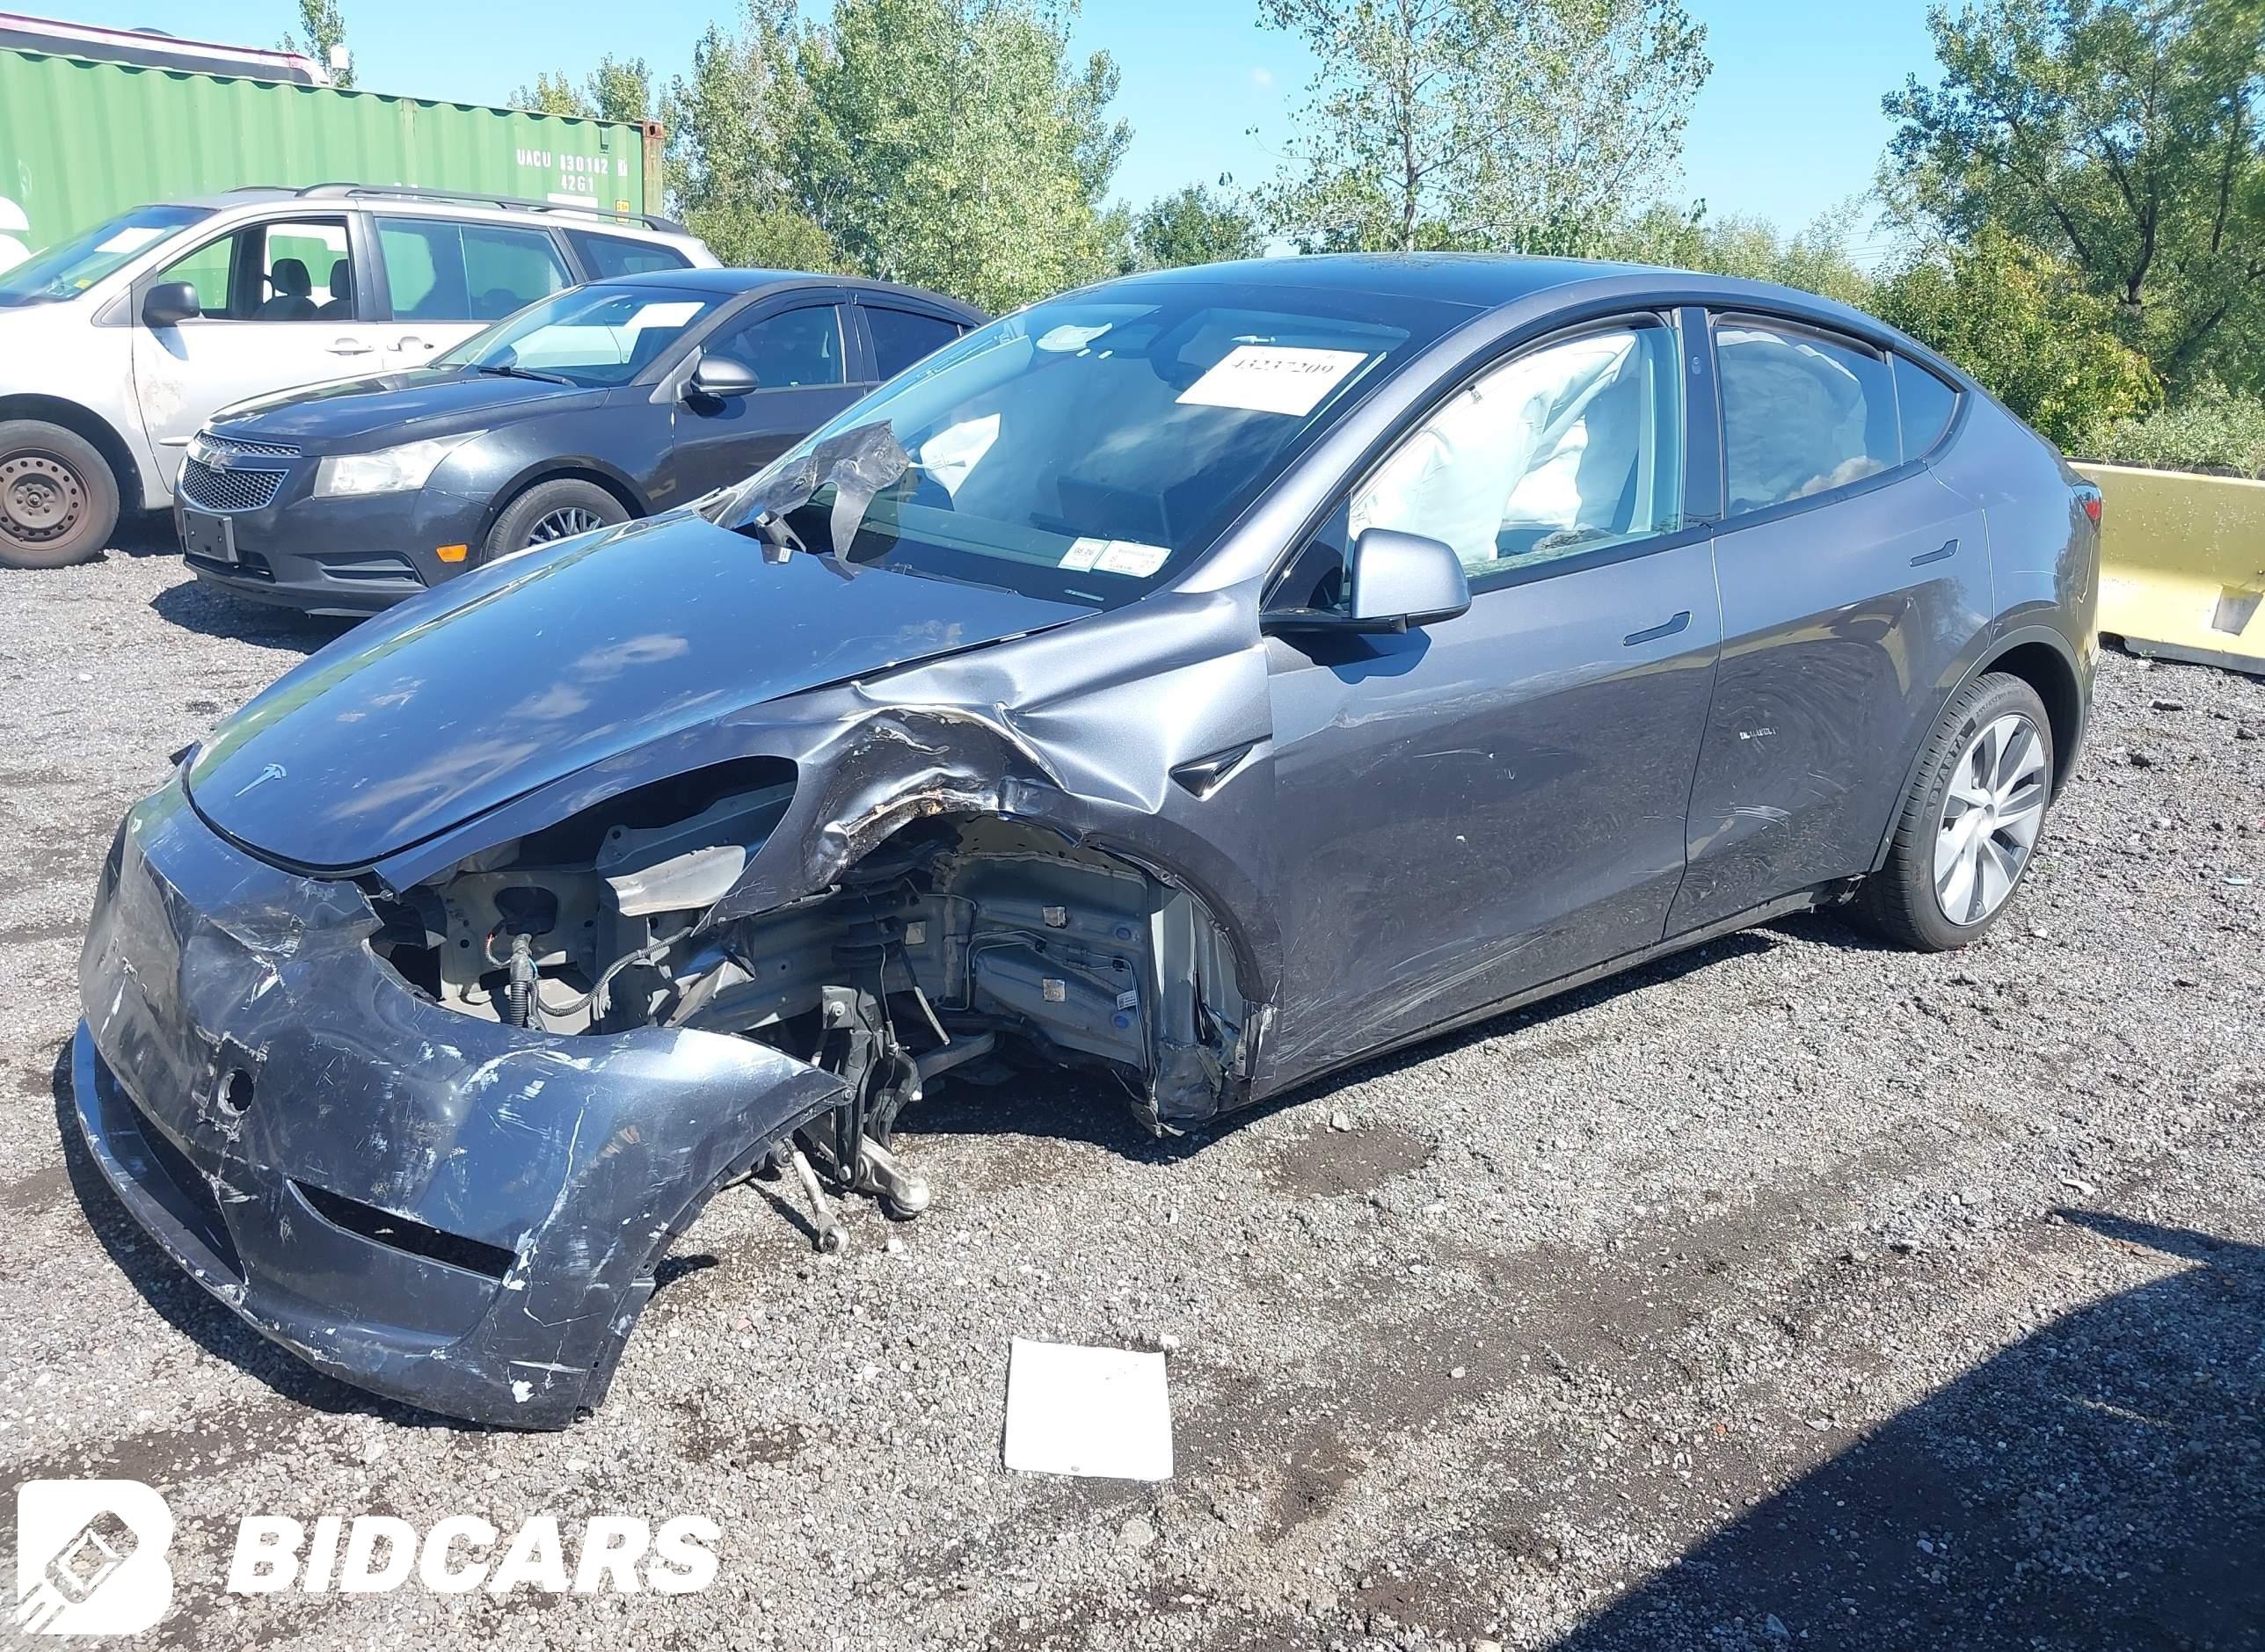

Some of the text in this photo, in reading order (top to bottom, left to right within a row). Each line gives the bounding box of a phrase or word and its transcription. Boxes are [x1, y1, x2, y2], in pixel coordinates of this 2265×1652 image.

[517, 149, 551, 168] UACU
[561, 174, 594, 193] 42G1
[1924, 733, 1966, 819] ADVANTA
